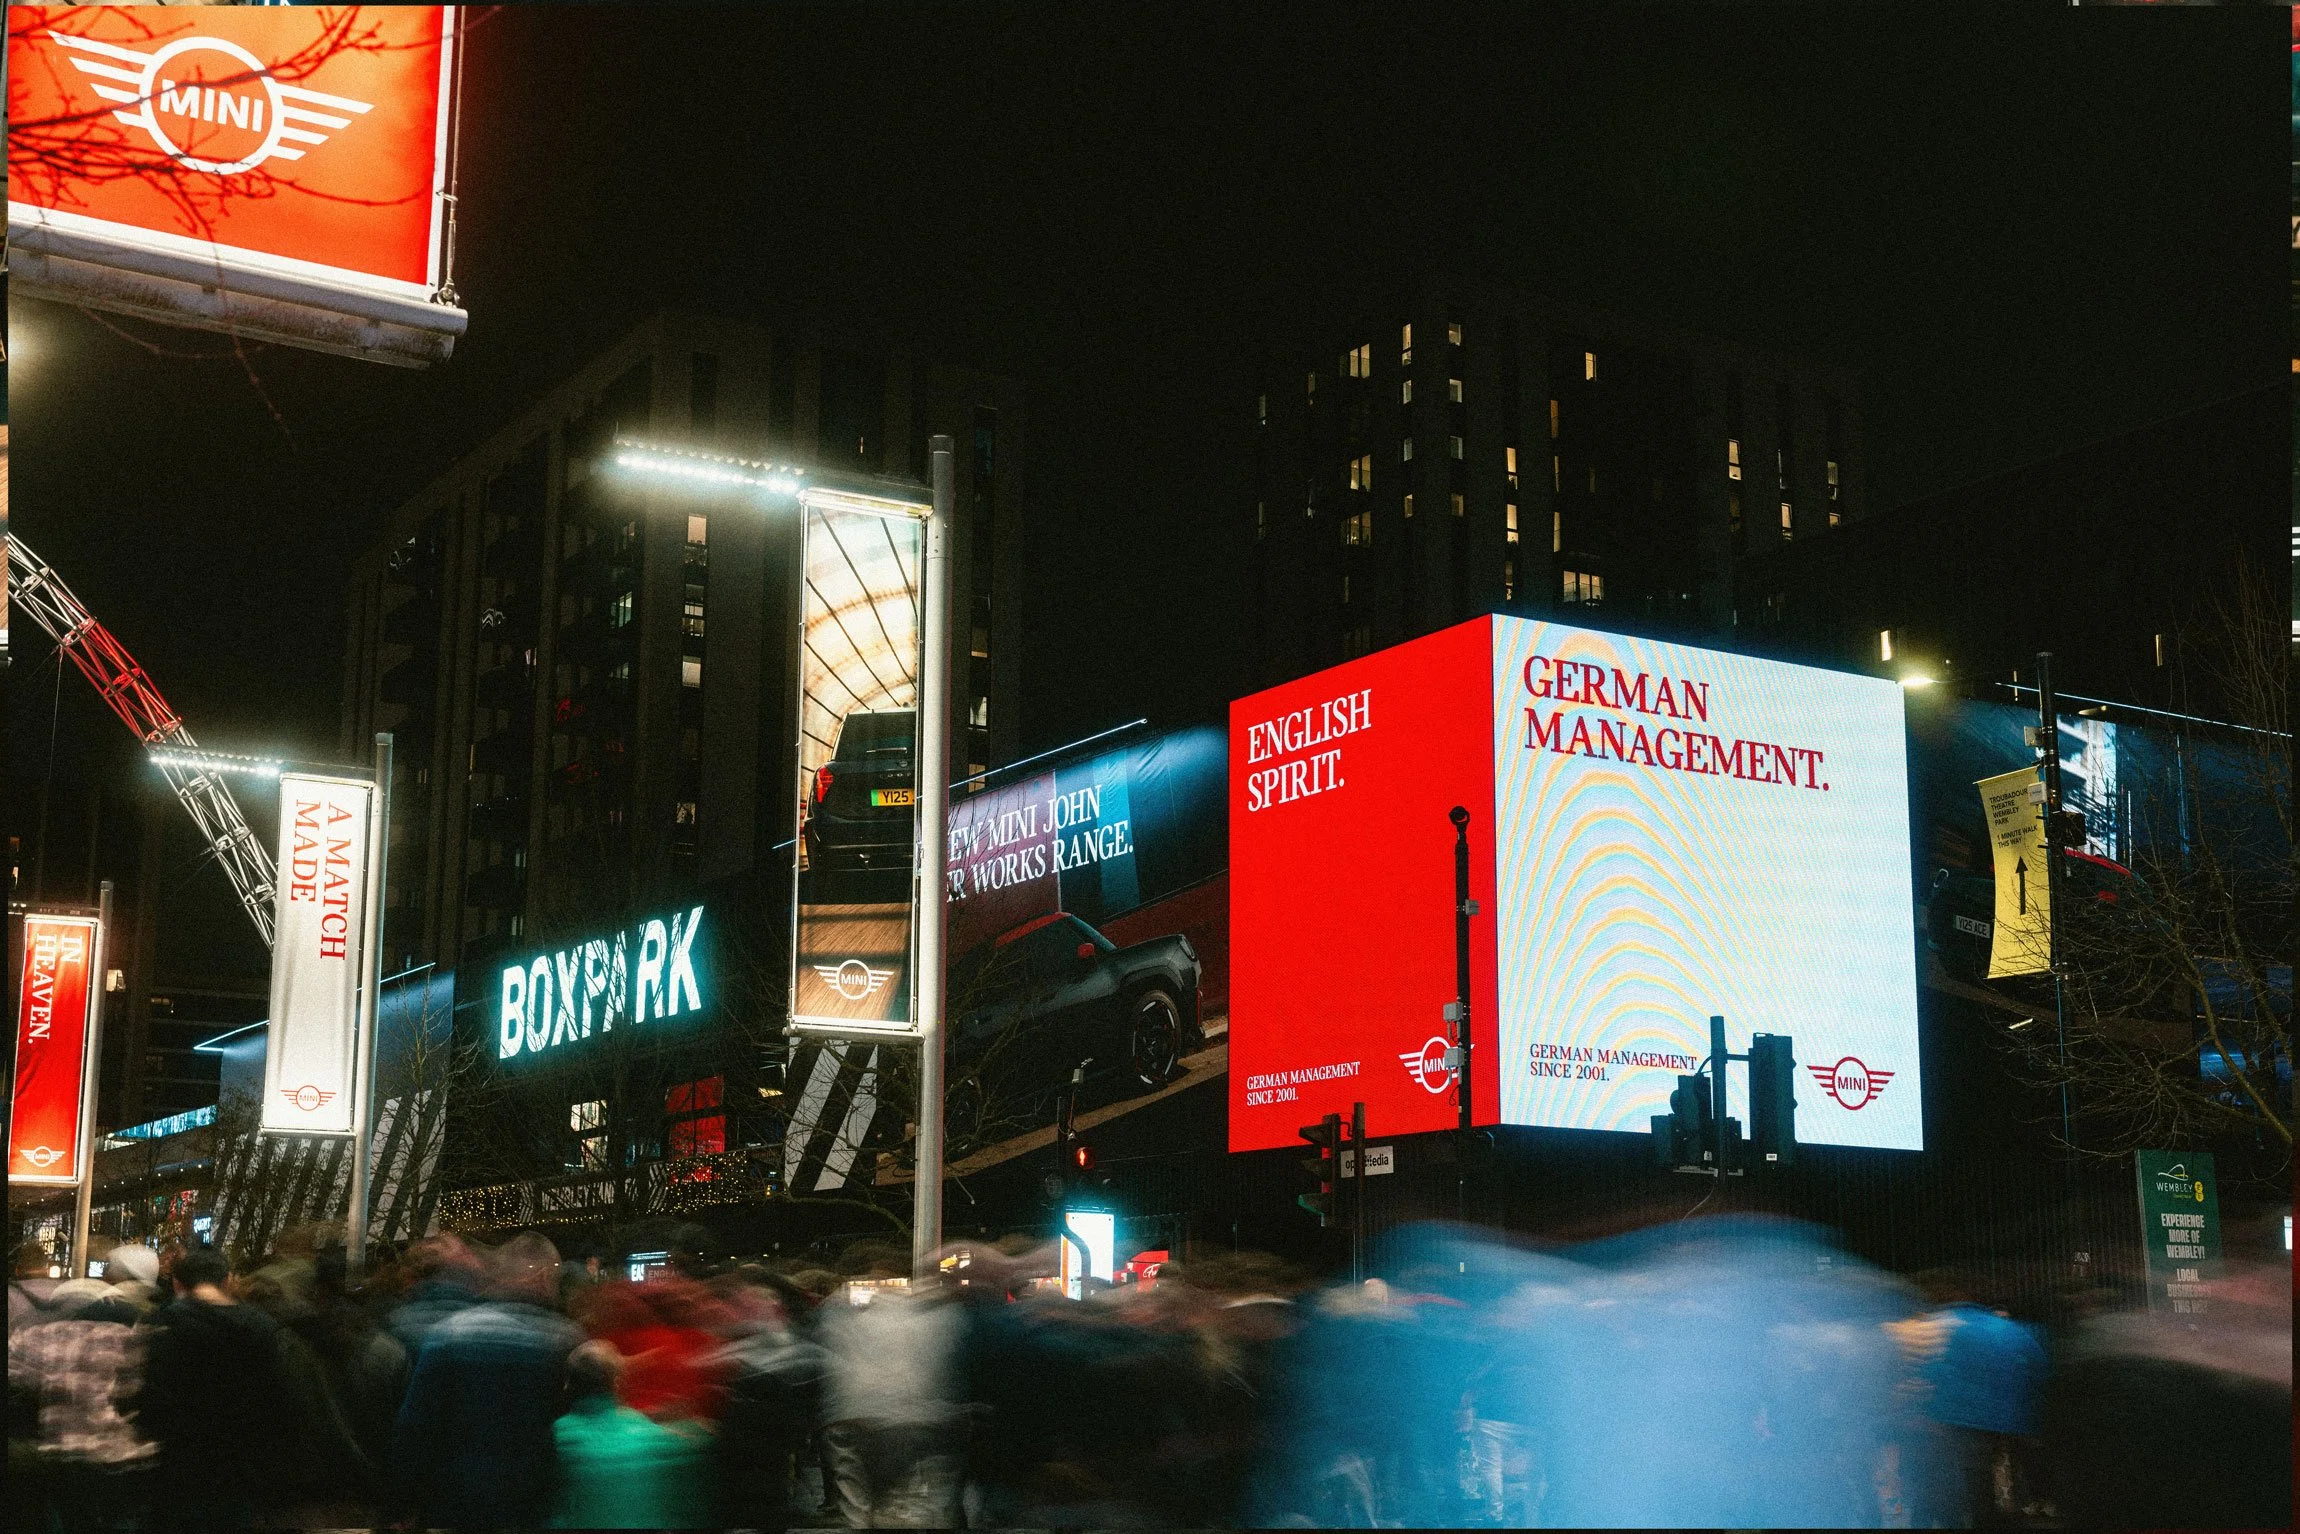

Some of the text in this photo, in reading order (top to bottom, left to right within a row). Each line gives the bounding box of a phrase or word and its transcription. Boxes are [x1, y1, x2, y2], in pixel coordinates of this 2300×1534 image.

[160, 78, 264, 133] MINI
[1523, 654, 1709, 723] GERMAN
[1247, 688, 1372, 765] ENGLISH
[1523, 706, 1830, 792] MANAGEMENT.
[1247, 748, 1345, 812] SPIRIT.
[883, 790, 909, 803] Y125
[1989, 788, 2028, 804] TROUBADOUR
[1991, 800, 2015, 811] THEATRE
[988, 804, 1038, 850] MINI
[1043, 784, 1102, 833] JOHN
[1993, 806, 2019, 819] WEMBLEY
[1995, 817, 2009, 826] PARK
[2001, 828, 2021, 840] MINUTE
[2022, 824, 2038, 836] WALK
[290, 799, 321, 902] MADE
[1998, 836, 2022, 849] THIS WAY
[971, 845, 1046, 894] WORKS
[1051, 820, 1134, 874] RANGE.
[319, 801, 353, 961] A MATCH
[60, 933, 83, 965] IN
[28, 932, 58, 1044] HEAVEN.
[499, 905, 704, 1059] BOXPARK
[841, 973, 867, 986] MINI
[1424, 1057, 1449, 1073] MIN
[1529, 1043, 1697, 1071] GERMAN MANAGEMENT
[1247, 1061, 1361, 1090] GERMAN MANAGEMENT
[1530, 1061, 1610, 1082] SINCE 2001.
[1837, 1076, 1867, 1092] MINI
[1246, 1086, 1299, 1106] SINCE 2001.
[2156, 1182, 2192, 1192] WEMBLEY
[2161, 1213, 2205, 1228] EXPERIENCE
[2169, 1229, 2200, 1243] MORE OF
[2166, 1245, 2206, 1259] WEMBLEY!
[2177, 1268, 2200, 1282] LOCAL
